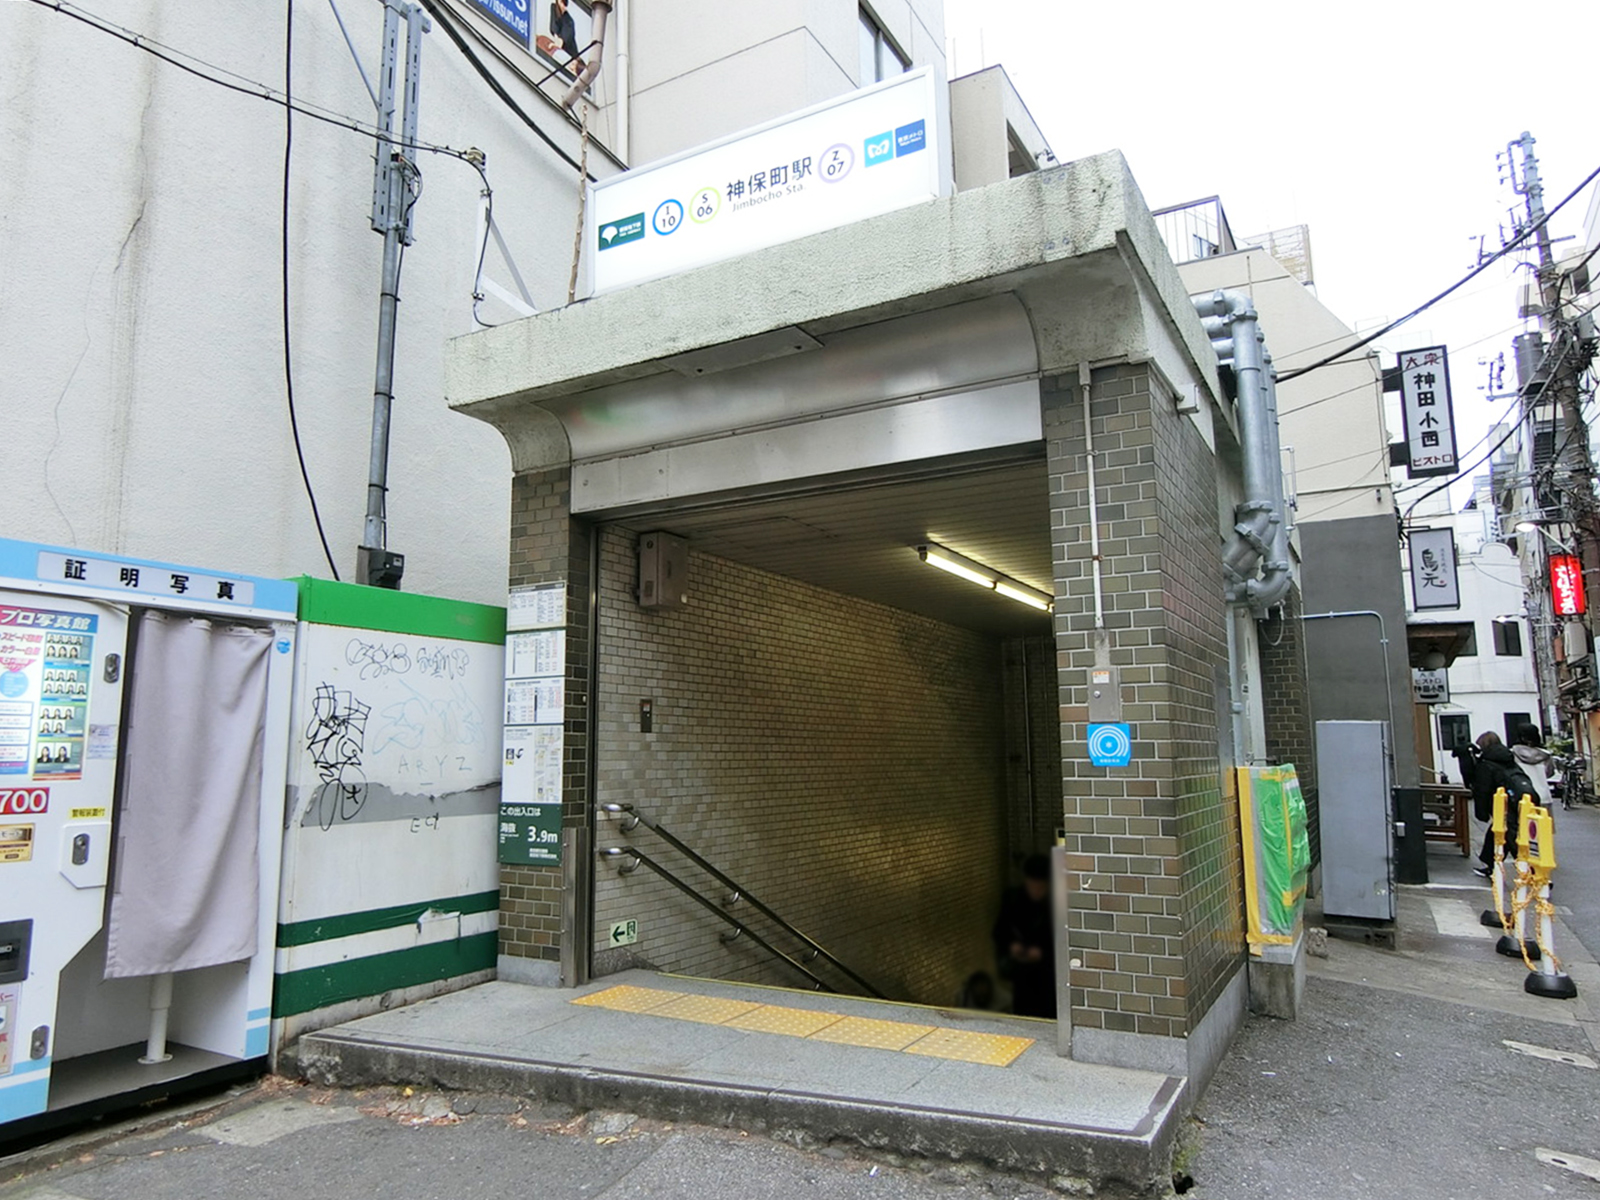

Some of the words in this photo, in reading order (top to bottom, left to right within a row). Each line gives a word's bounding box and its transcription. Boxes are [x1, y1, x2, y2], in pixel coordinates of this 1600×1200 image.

[832, 150, 839, 161] Z
[827, 161, 844, 176] 07
[726, 156, 812, 202] 神保町駅
[702, 193, 708, 204] S
[732, 191, 783, 212] Jimbocho
[786, 183, 806, 197] Sta.
[665, 205, 670, 215] I
[697, 204, 713, 217] 06
[662, 215, 676, 228] 10
[1413, 372, 1440, 448] 神田小西
[1412, 453, 1453, 468] ビストロ
[65, 558, 236, 601] 証明写真
[0, 609, 91, 631] プロ写真館
[0, 790, 47, 813] 700
[527, 825, 558, 843] 3.9m
